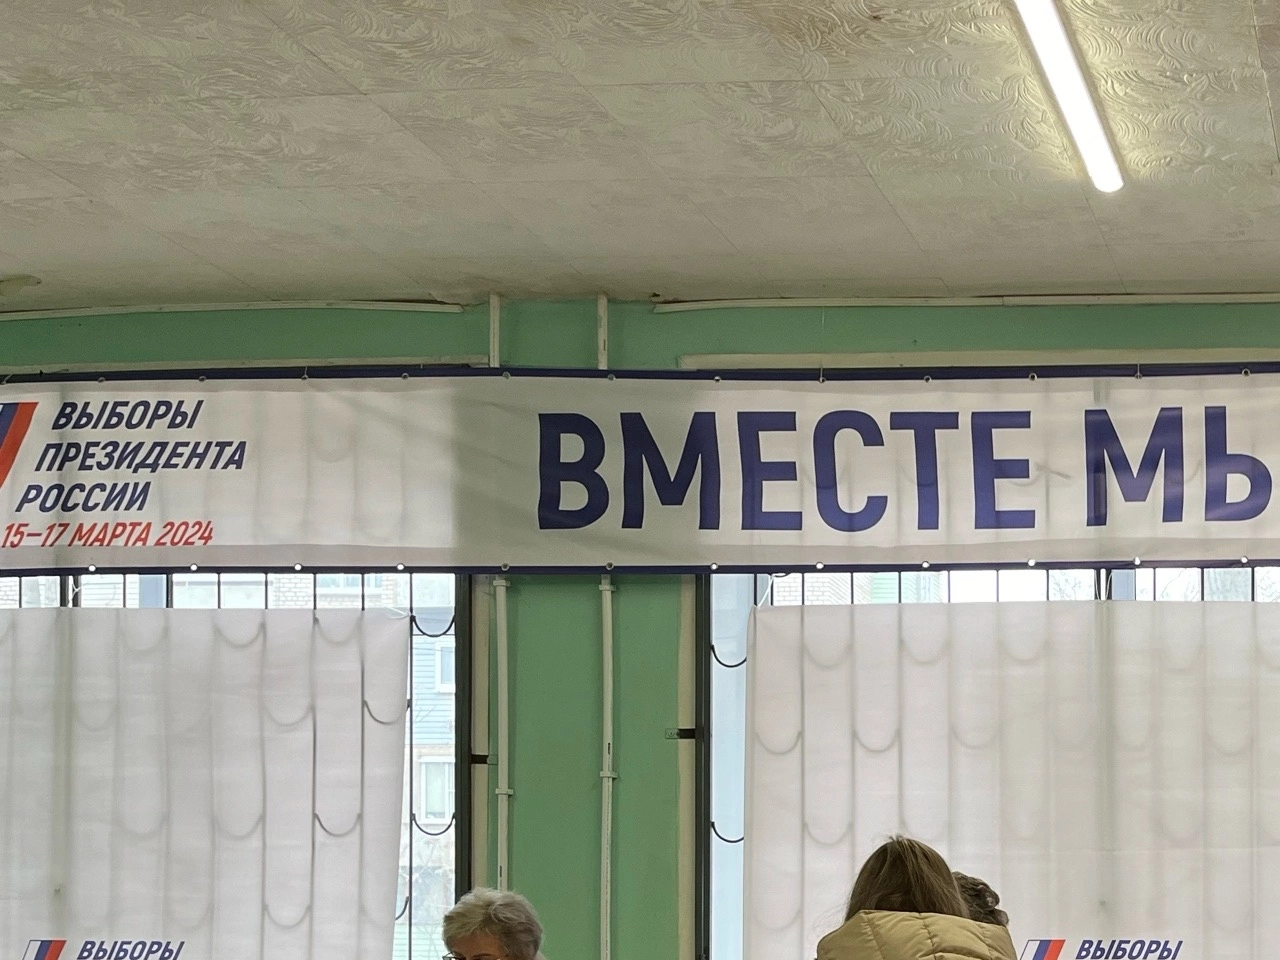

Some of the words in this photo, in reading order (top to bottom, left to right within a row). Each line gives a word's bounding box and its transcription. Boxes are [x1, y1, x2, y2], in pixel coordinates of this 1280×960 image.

[52, 400, 204, 430] ВЫБОРЫ
[35, 441, 247, 473] ПРЕЗИДЕНТА
[538, 409, 1036, 532] ВМЕСТЕ
[15, 482, 151, 513] РОССИИ
[68, 522, 152, 547] МАРТА
[154, 521, 213, 547] 2024
[77, 940, 185, 960] ВЫБОРЫ
[1075, 939, 1183, 960] ВЫБОРЫ
